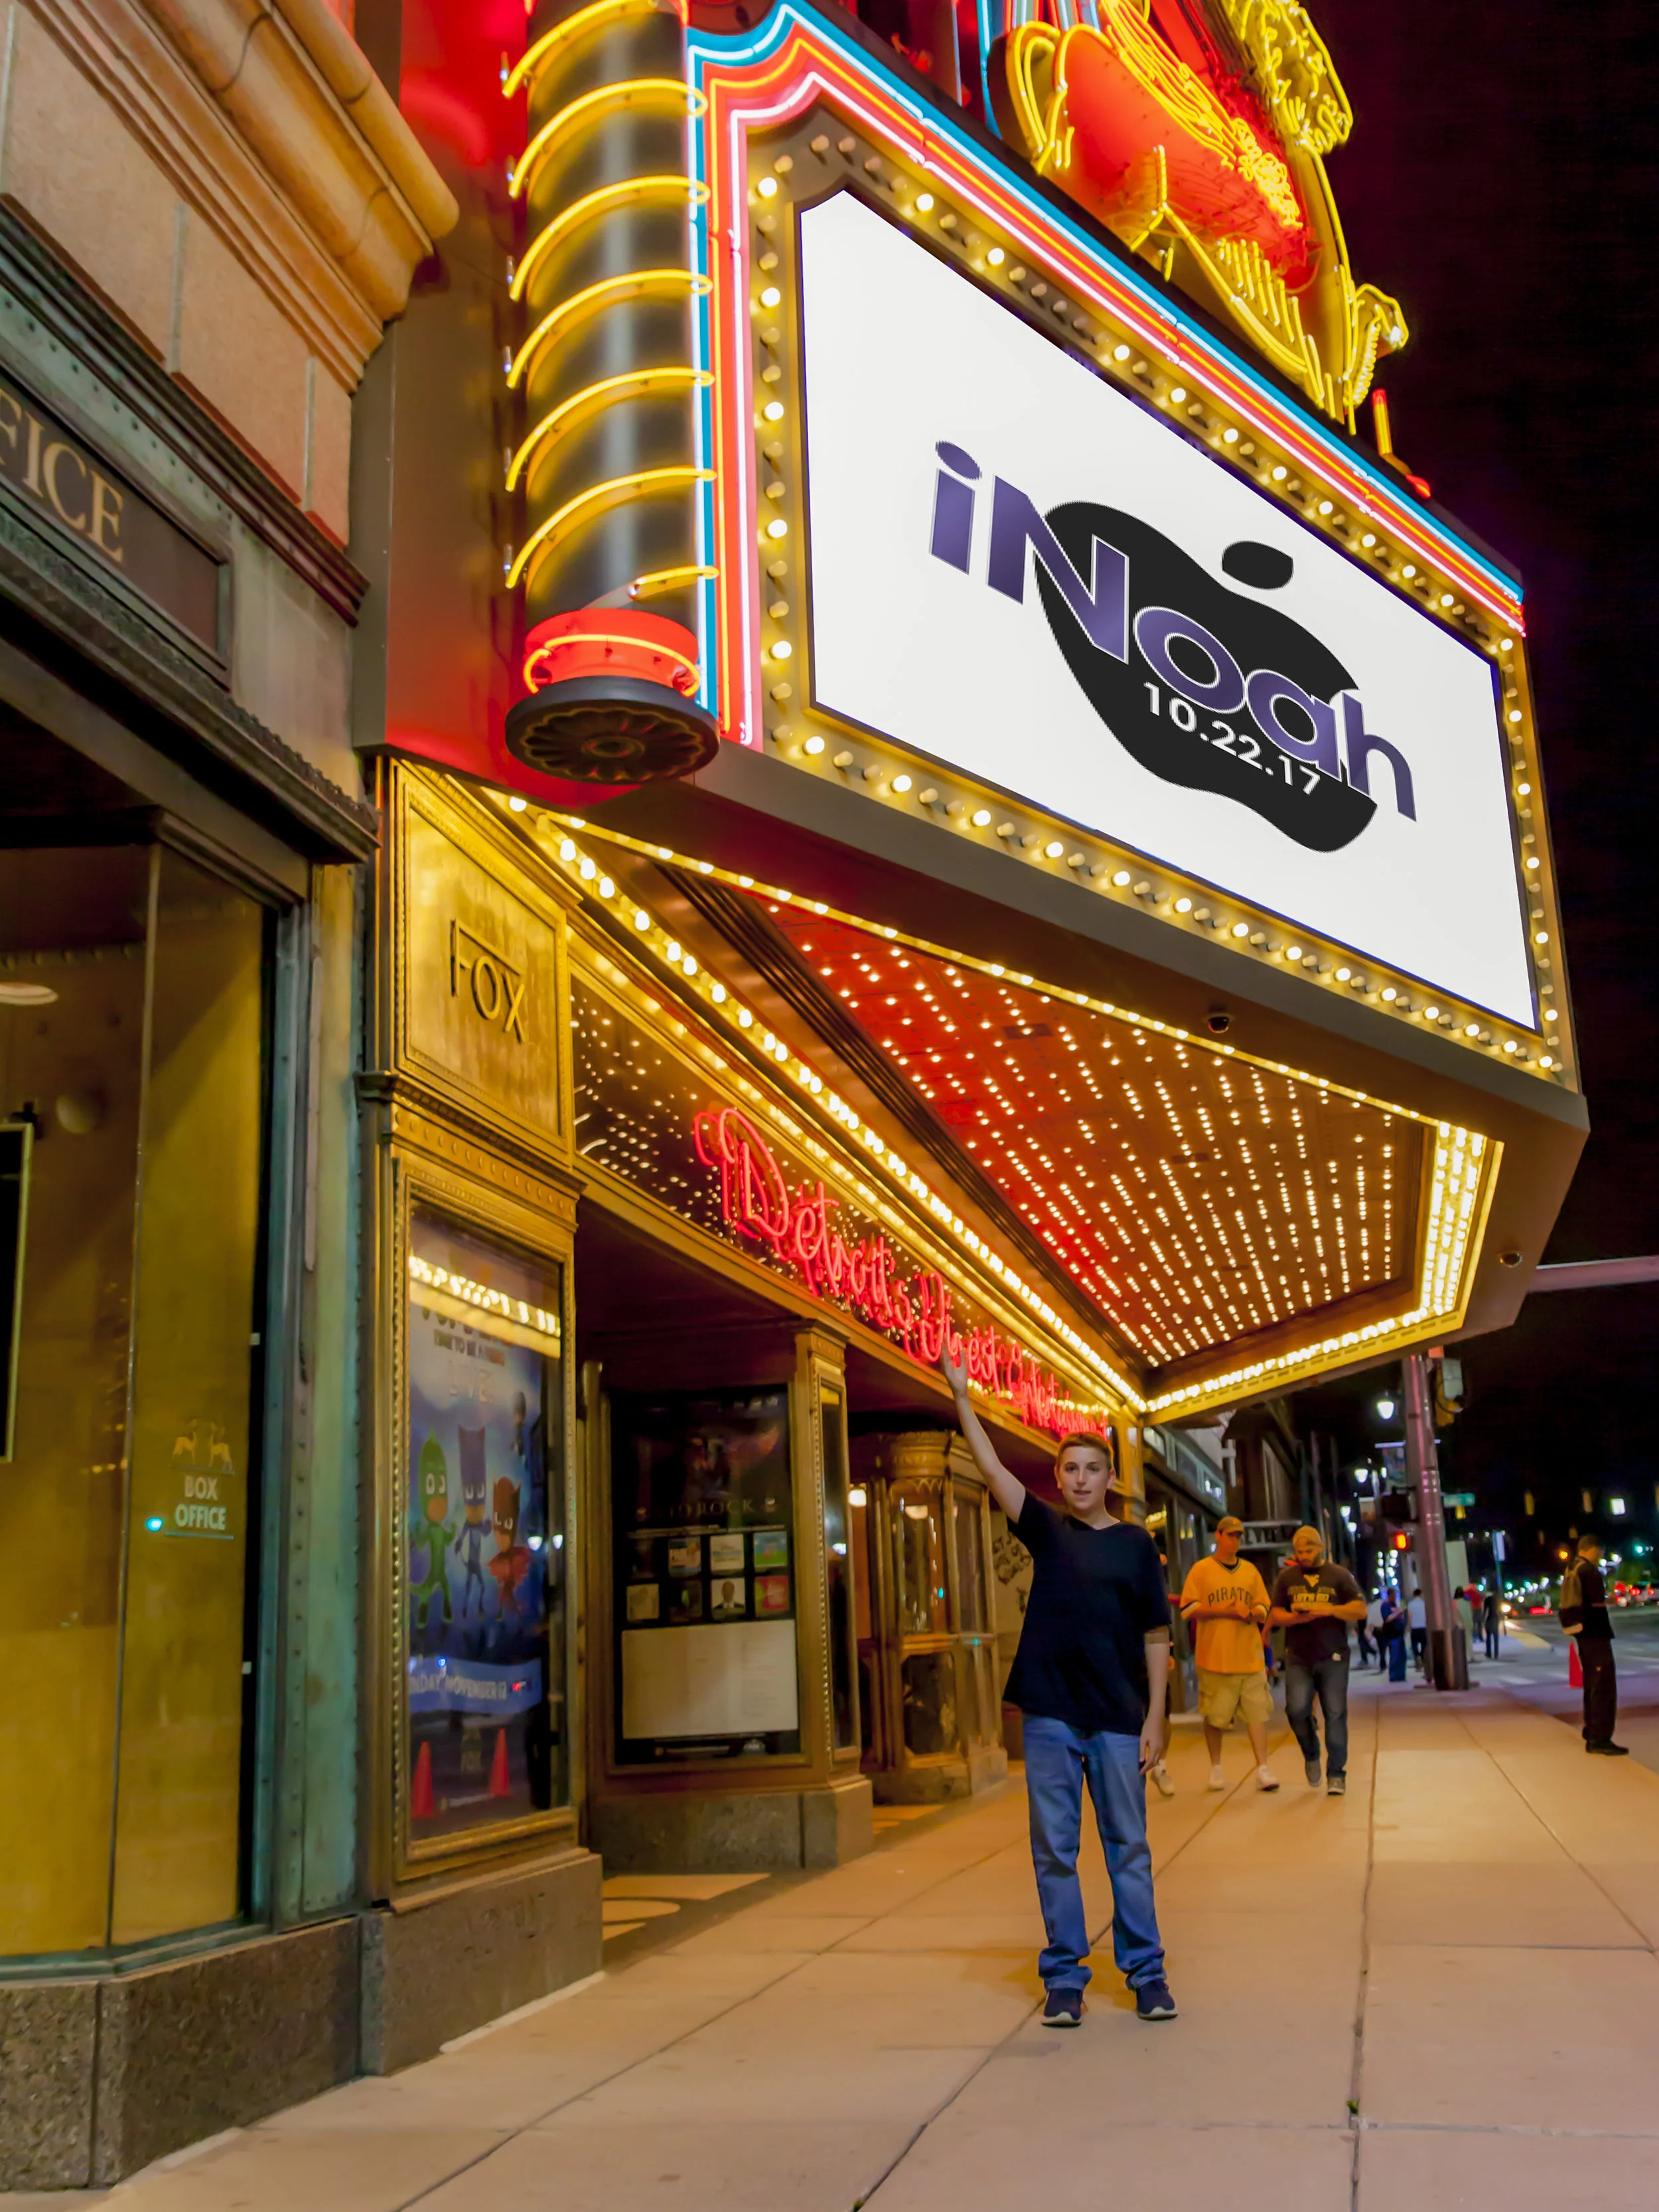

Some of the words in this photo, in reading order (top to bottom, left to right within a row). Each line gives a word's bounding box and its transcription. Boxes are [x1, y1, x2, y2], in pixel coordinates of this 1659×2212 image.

[929, 440, 1417, 822] iNoah
[1143, 682, 1322, 796] 10.22.17
[451, 919, 526, 1045] FOX
[175, 1503, 227, 1531] OFFICE
[184, 1475, 218, 1501] BOX
